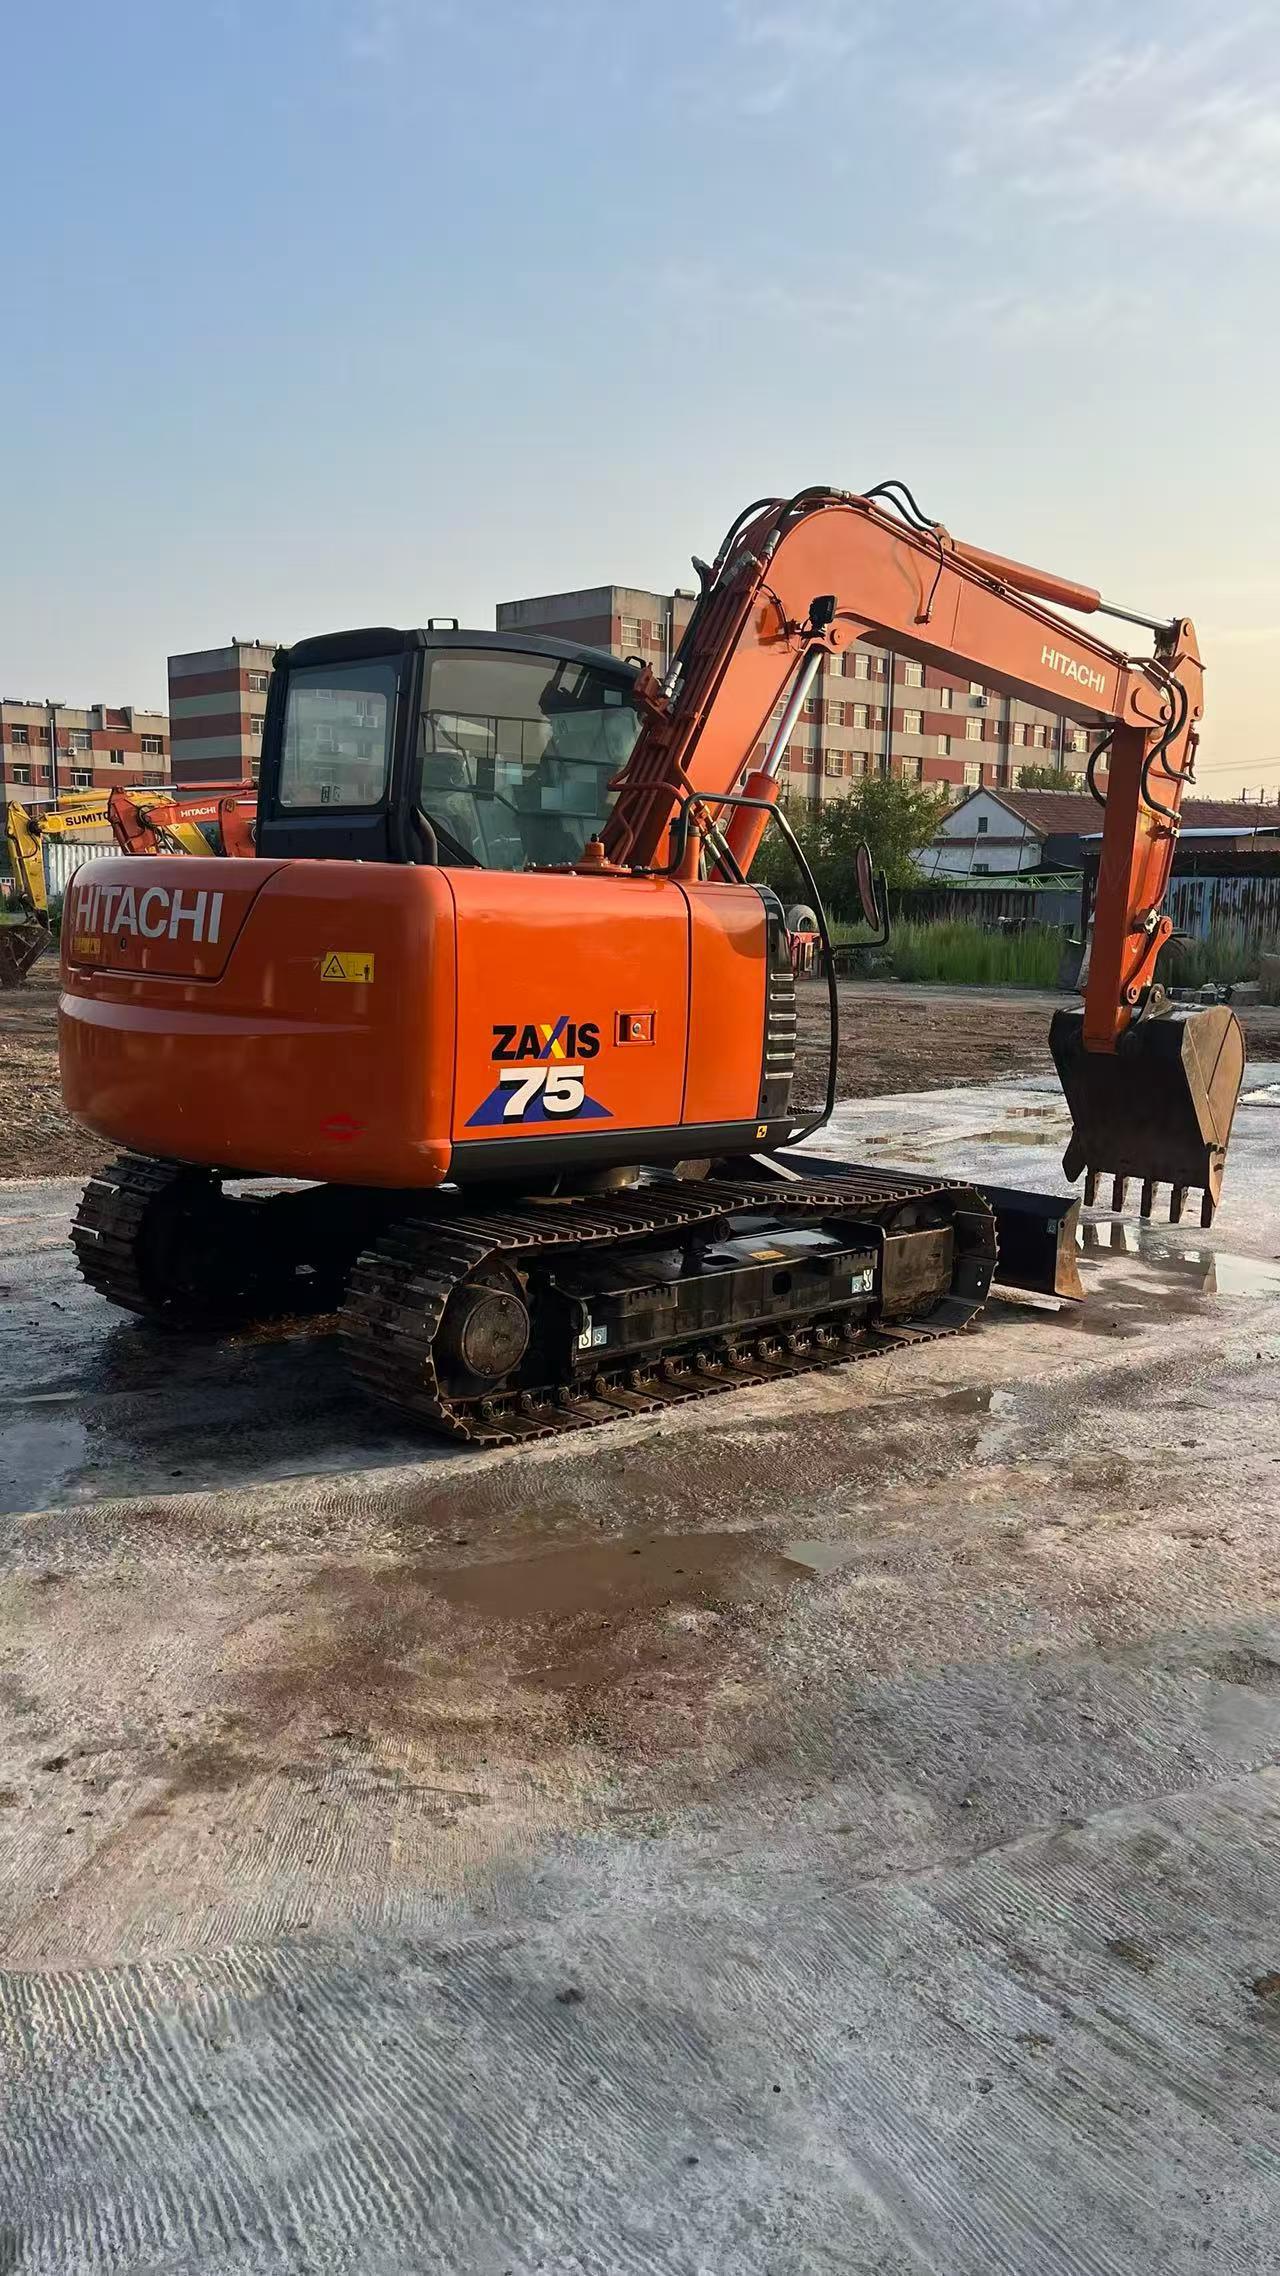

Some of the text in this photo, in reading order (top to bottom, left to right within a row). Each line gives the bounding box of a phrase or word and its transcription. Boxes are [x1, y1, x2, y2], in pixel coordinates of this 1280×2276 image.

[1040, 645, 1105, 694] HITACHI
[180, 806, 216, 818] HITACHI
[75, 886, 224, 943] HITACHI
[491, 1015, 600, 1060] ZAXIS
[500, 1065, 585, 1121] 75
